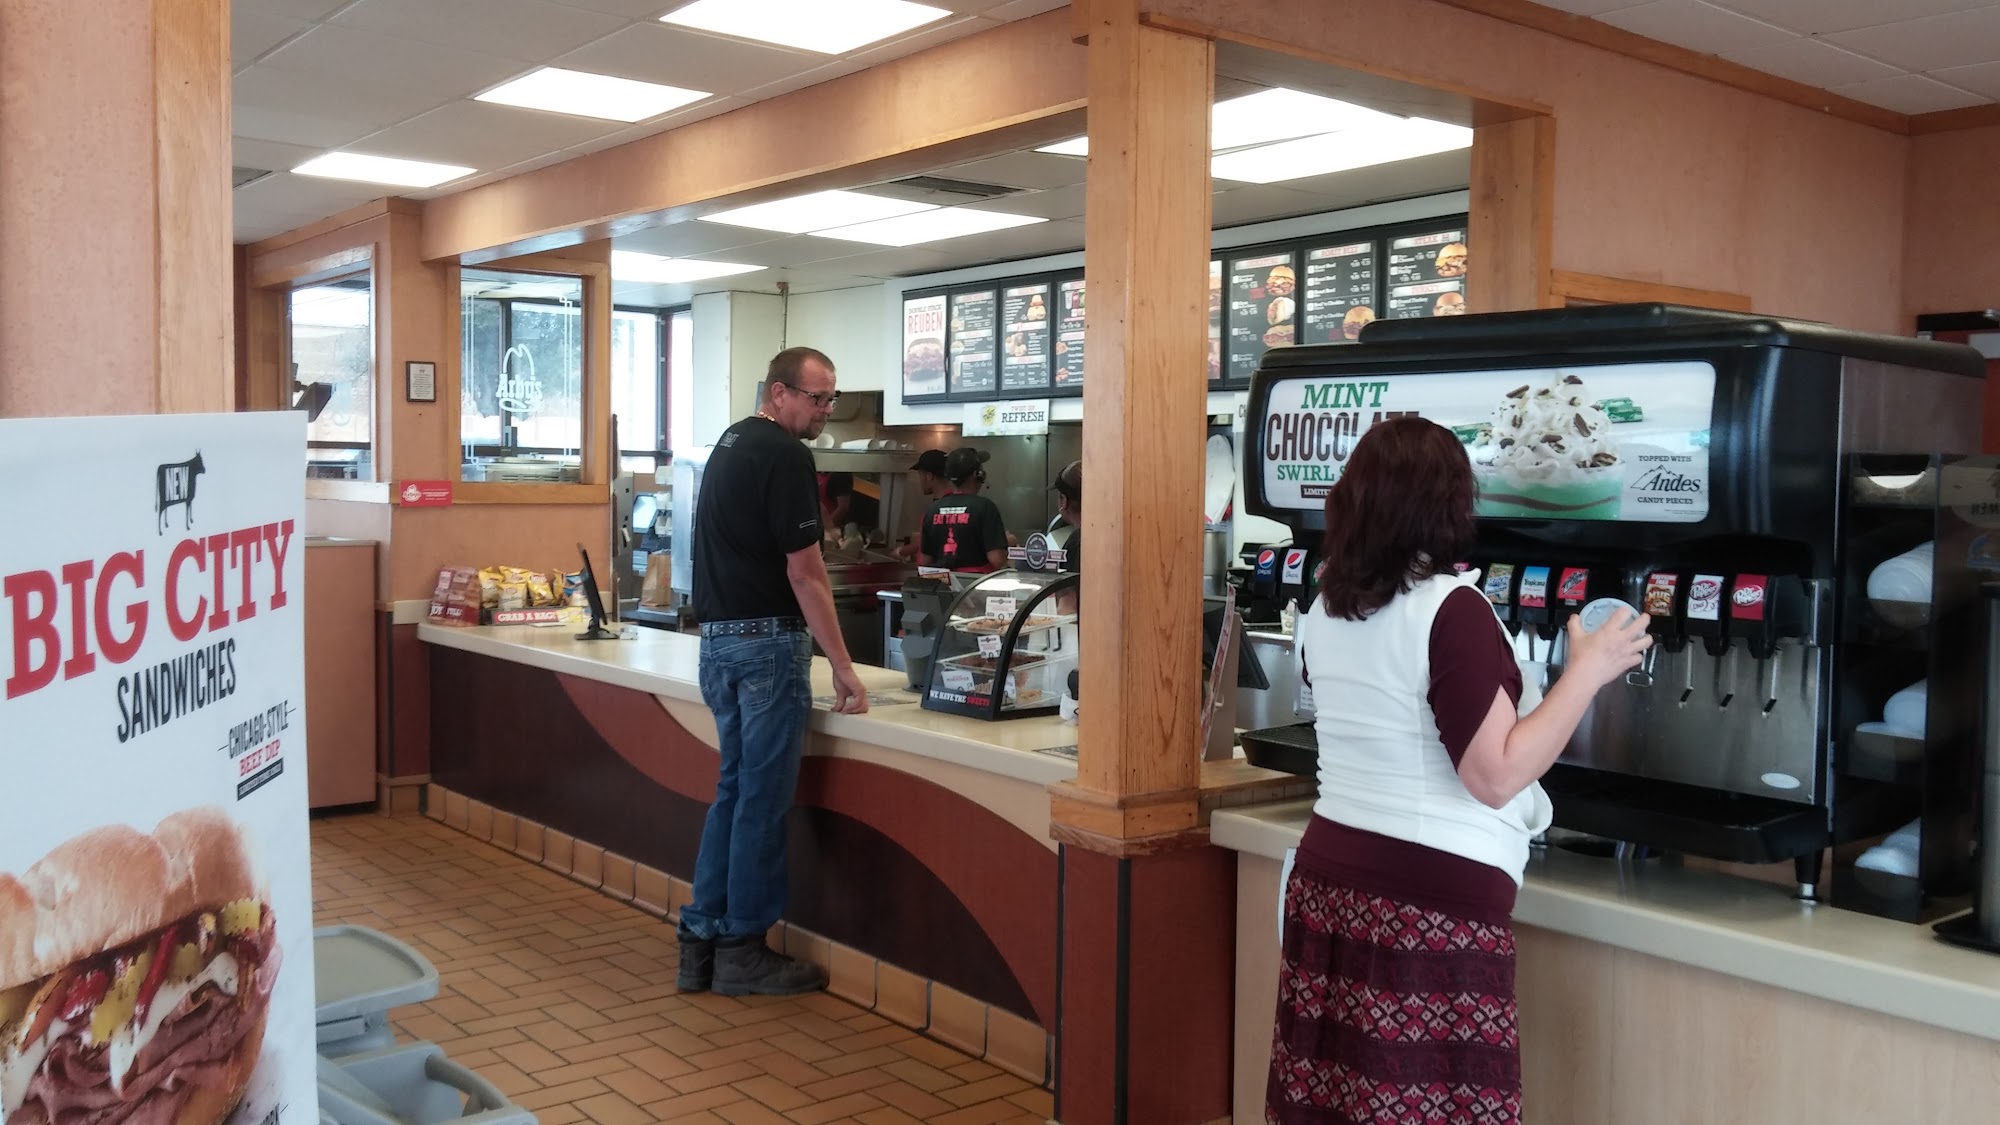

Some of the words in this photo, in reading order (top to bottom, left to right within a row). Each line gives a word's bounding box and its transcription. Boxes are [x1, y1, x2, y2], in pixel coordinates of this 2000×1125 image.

[908, 310, 943, 336] REUBEN
[495, 373, 543, 405] Arby's
[1301, 382, 1389, 409] MINT
[1001, 411, 1045, 423] REFRESH
[164, 465, 190, 501] NEW
[1277, 464, 1335, 481] SWIRL
[1640, 473, 1701, 492] Andes
[1524, 578, 1546, 587] Tropicana
[4, 548, 149, 701] BIG
[165, 518, 295, 643] CITY
[117, 637, 236, 743] SANDWICHES
[265, 738, 281, 762] DIP
